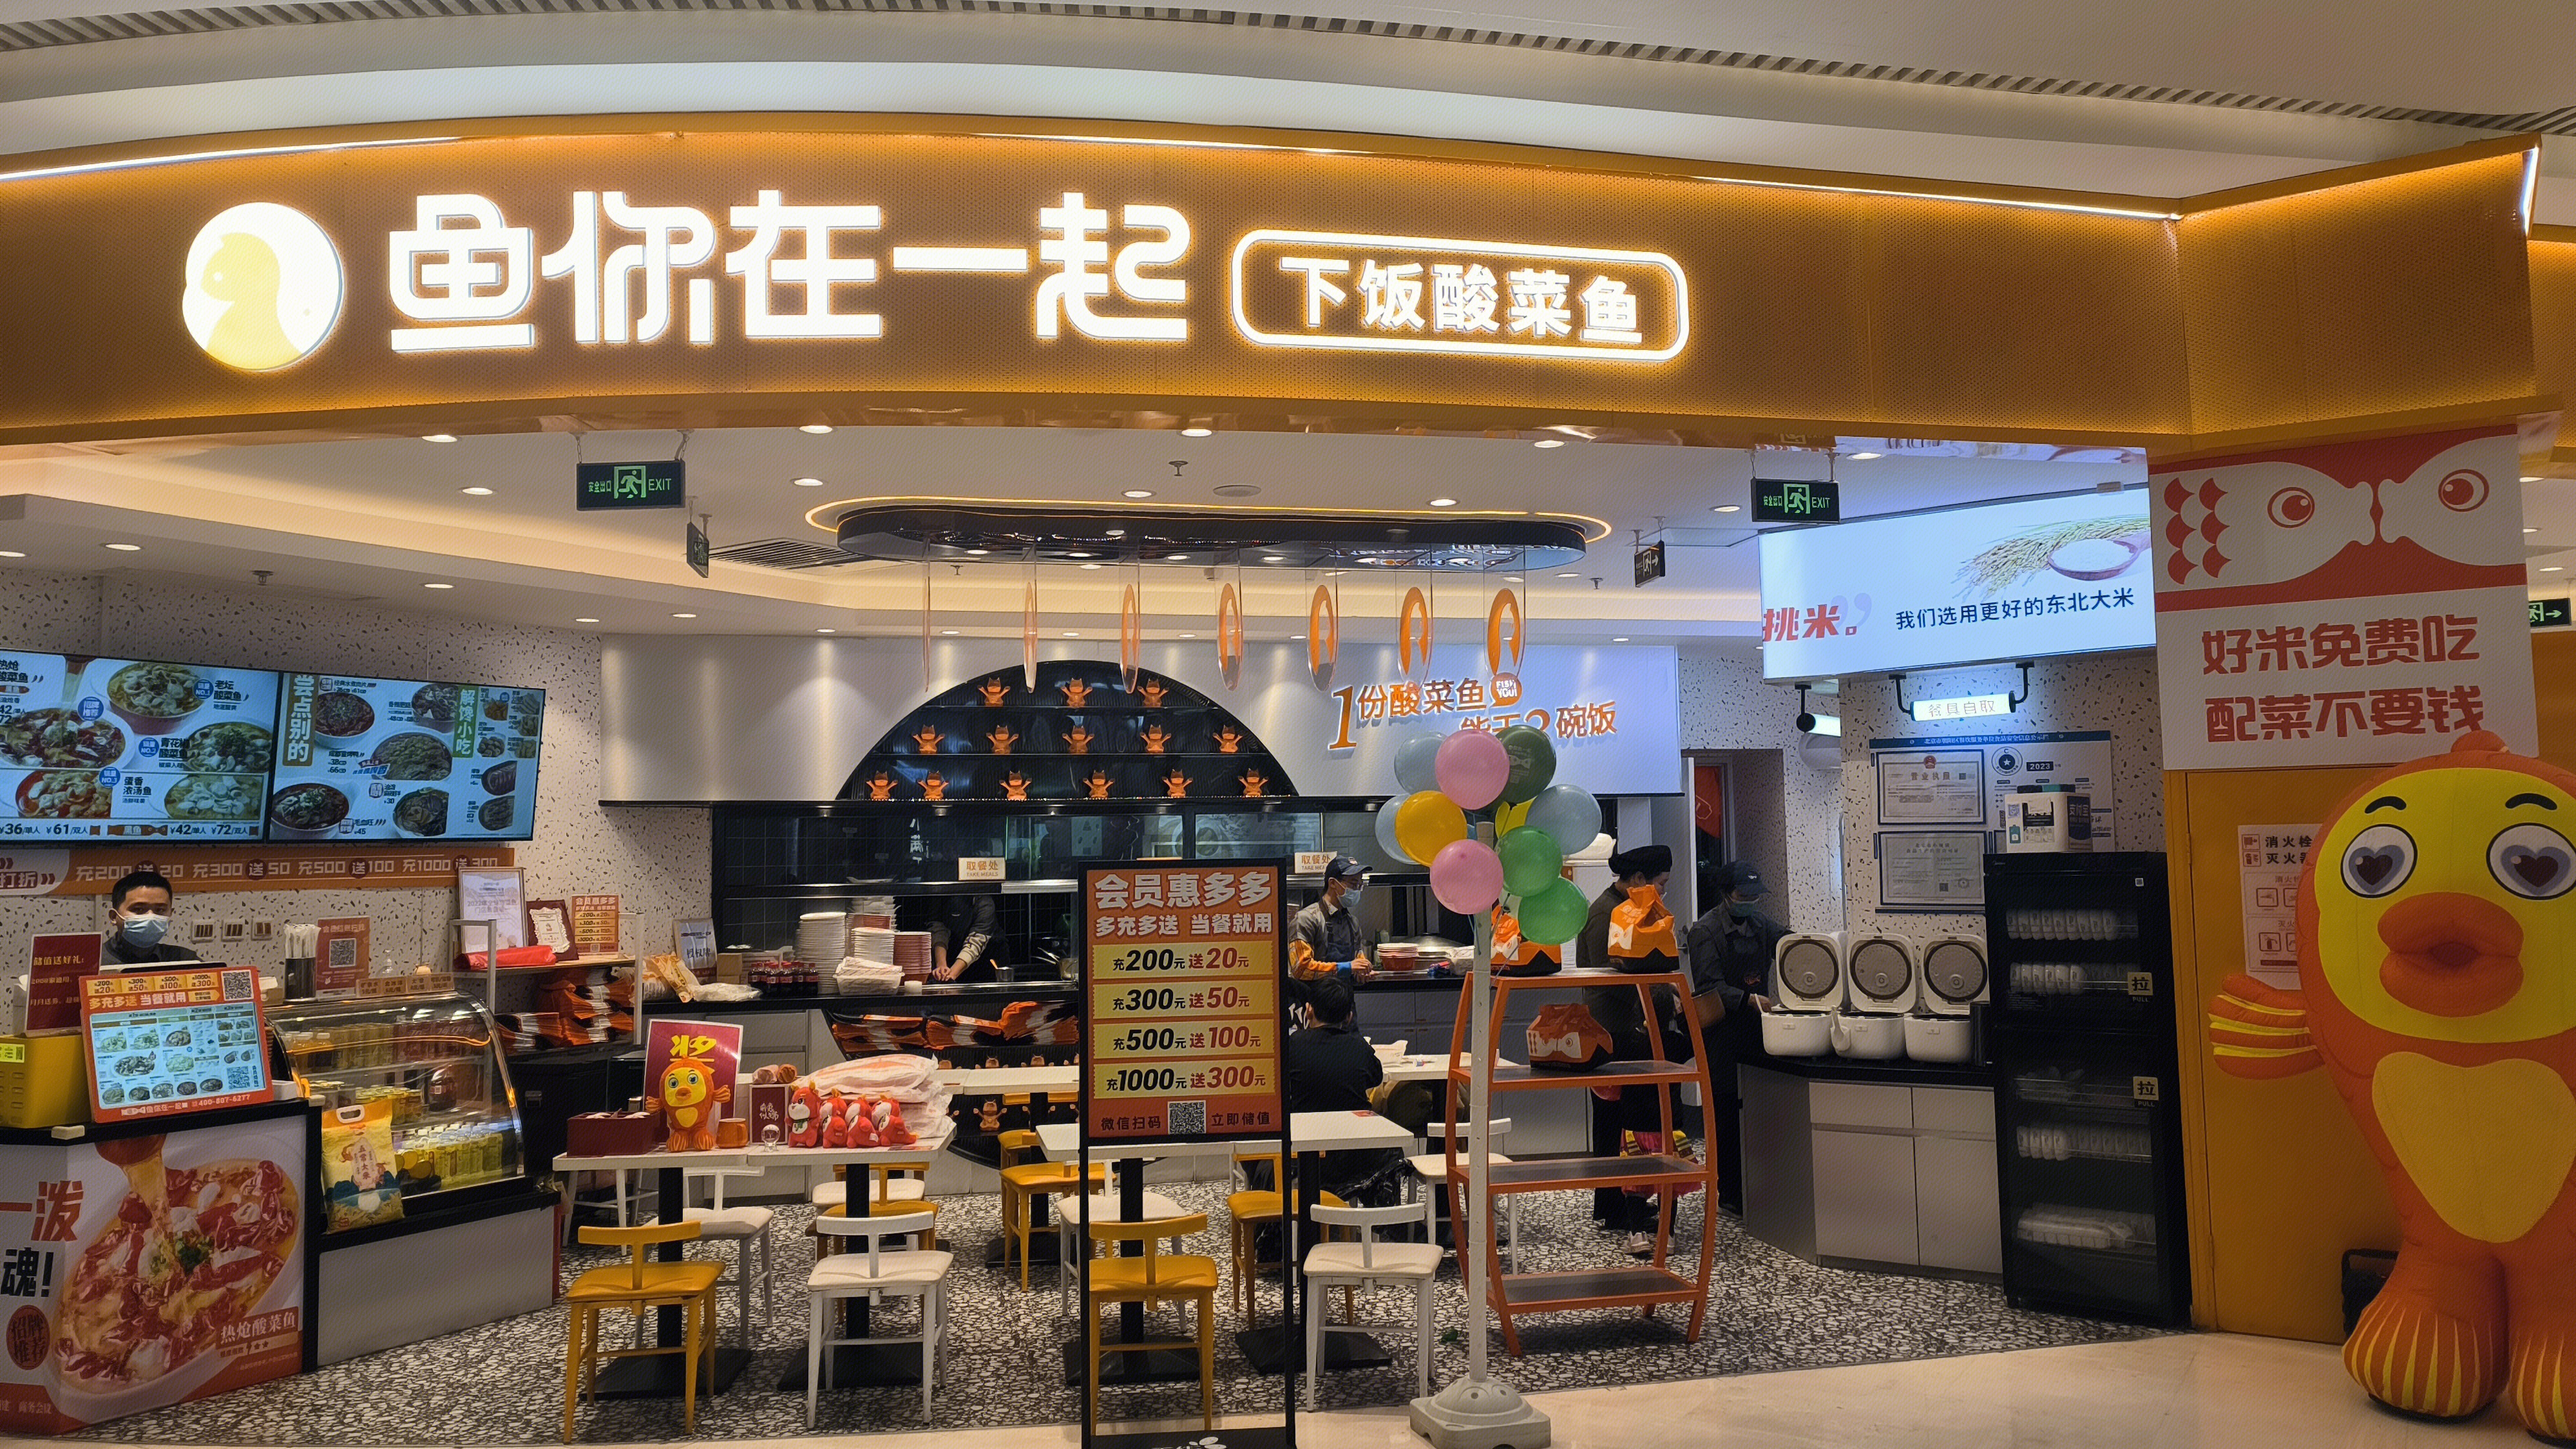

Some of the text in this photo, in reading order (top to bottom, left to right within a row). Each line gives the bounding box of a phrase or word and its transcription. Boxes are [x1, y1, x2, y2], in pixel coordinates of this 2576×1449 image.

[390, 190, 1191, 351] 鱼你在一起
[1280, 256, 1642, 343] 下饭酸菜鱼
[649, 478, 672, 491] EXIT
[1811, 497, 1831, 508] EXIT
[1896, 588, 2135, 631] 我们选用更好的东北大米
[2201, 614, 2480, 675] 好米免费吃
[214, 680, 234, 690] 老坛
[214, 691, 242, 702] 酸菜鱼
[288, 674, 314, 762] 尝点别的
[1927, 699, 1996, 718] 餐具自取
[2205, 685, 2484, 743] 配菜不要钱
[2265, 835, 2313, 848] 消火栓
[966, 860, 998, 871] 取餐处
[1301, 854, 1331, 865] 取餐处
[1095, 871, 1271, 910] 会员惠多多
[1095, 913, 1272, 937] 多充多送 当餐就用
[2131, 976, 2149, 991] 拉
[90, 995, 138, 1009] 多充多送
[2137, 1081, 2155, 1096] 拉
[1100, 1111, 1270, 1132] 微信扫码 立即储值
[0, 1180, 84, 1241] 一泼
